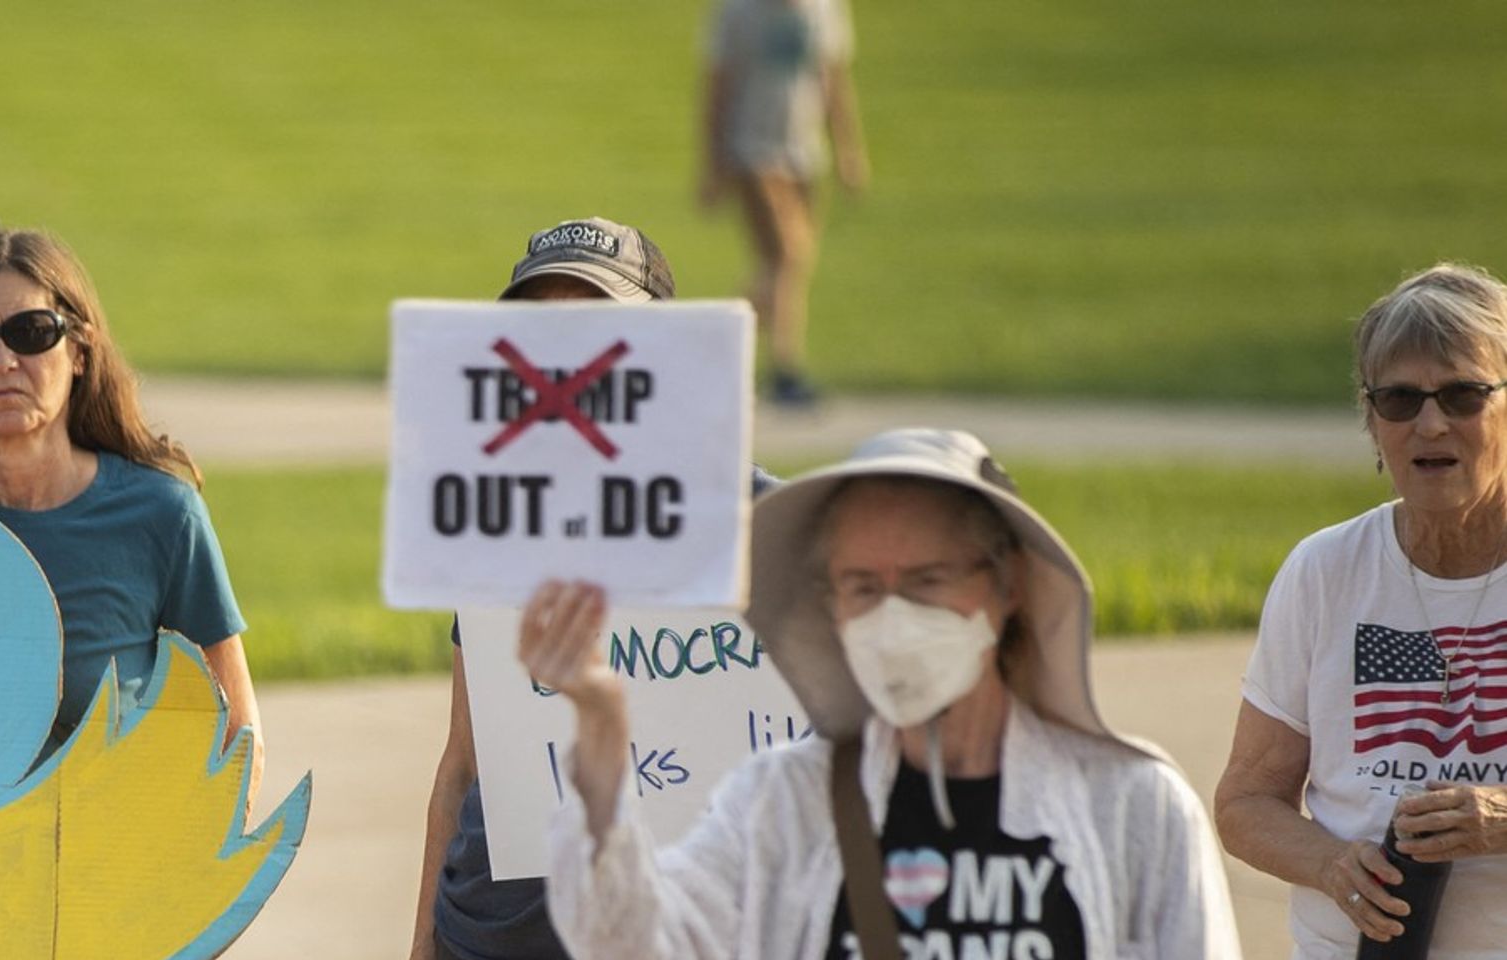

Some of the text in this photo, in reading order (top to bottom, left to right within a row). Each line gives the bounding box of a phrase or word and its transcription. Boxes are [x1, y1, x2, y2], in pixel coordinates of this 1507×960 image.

[463, 366, 653, 423] TRMP
[432, 473, 551, 538] OUT
[600, 474, 685, 539] DC
[1372, 759, 1428, 781] OLD
[1438, 761, 1507, 782] NAVY
[949, 848, 1056, 925] MY
